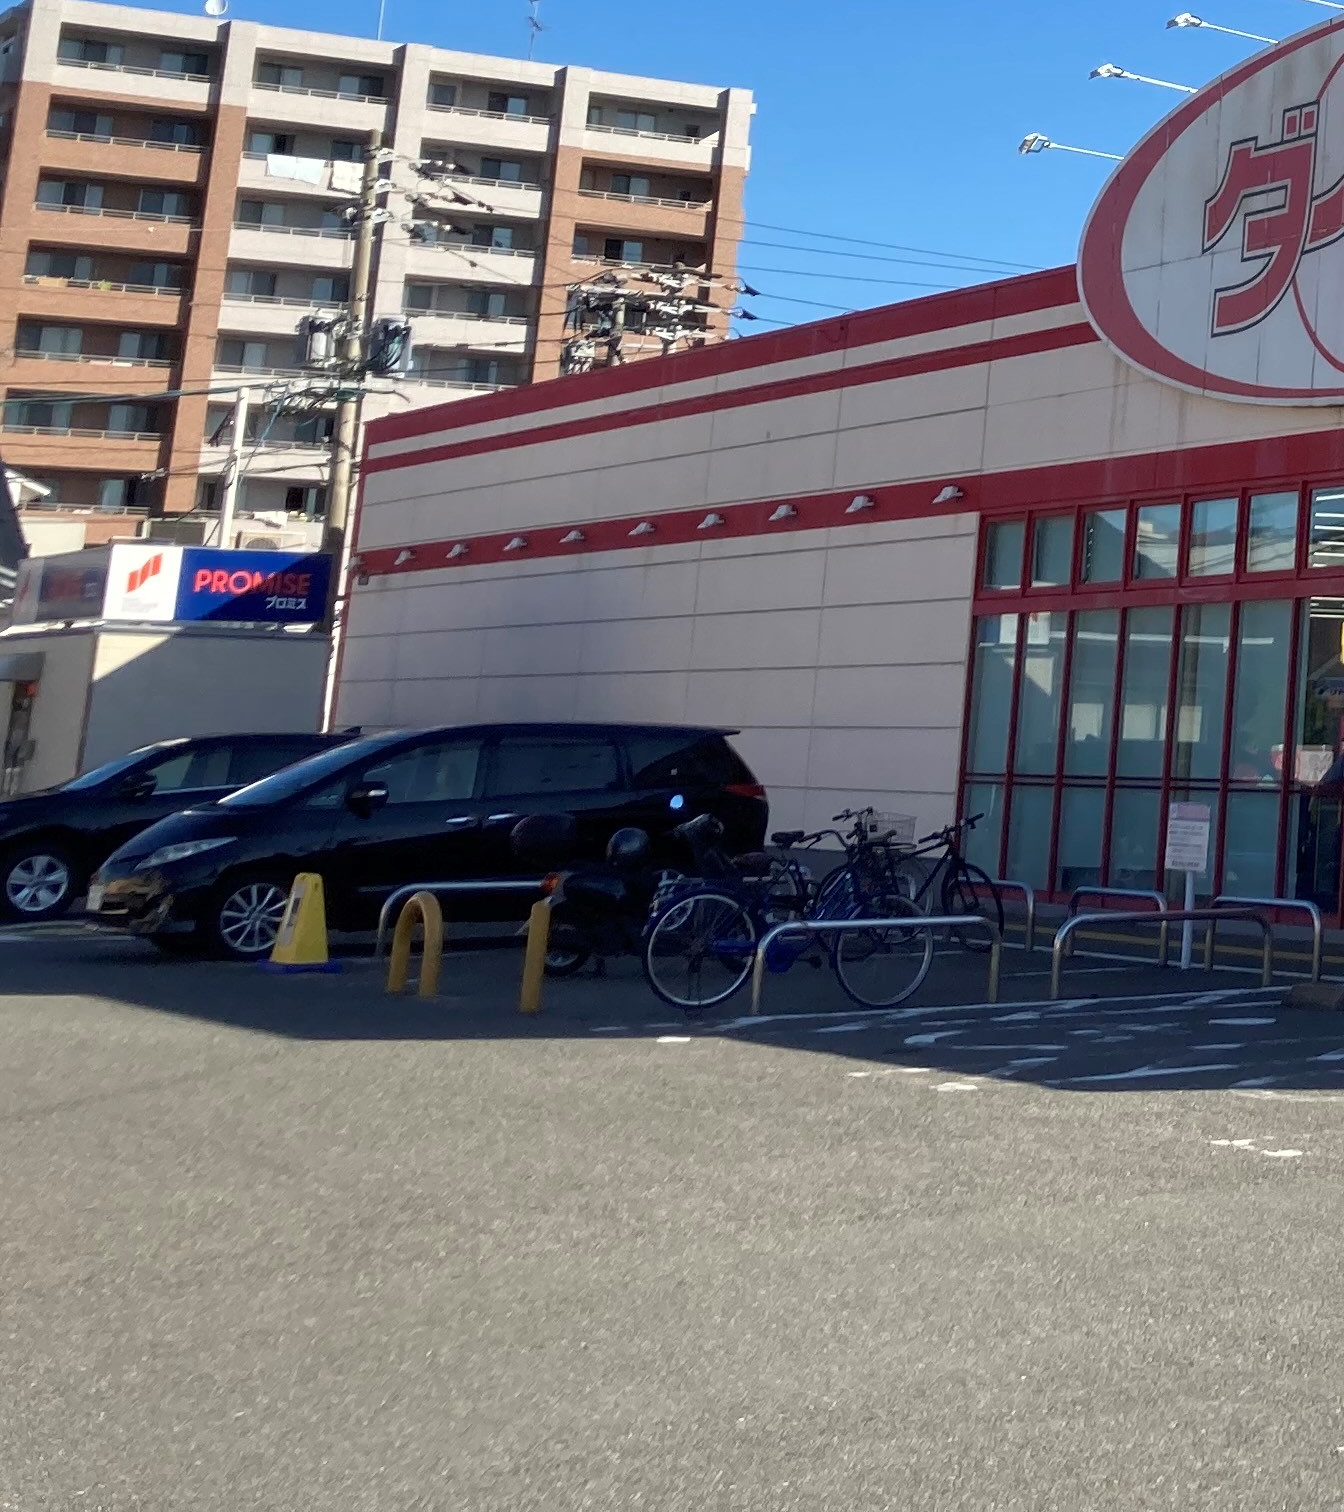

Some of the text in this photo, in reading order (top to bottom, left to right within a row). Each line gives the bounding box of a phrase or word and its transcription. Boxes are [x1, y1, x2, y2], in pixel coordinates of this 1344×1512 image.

[193, 568, 312, 596] PROMISE
[265, 595, 308, 610] プロミス
